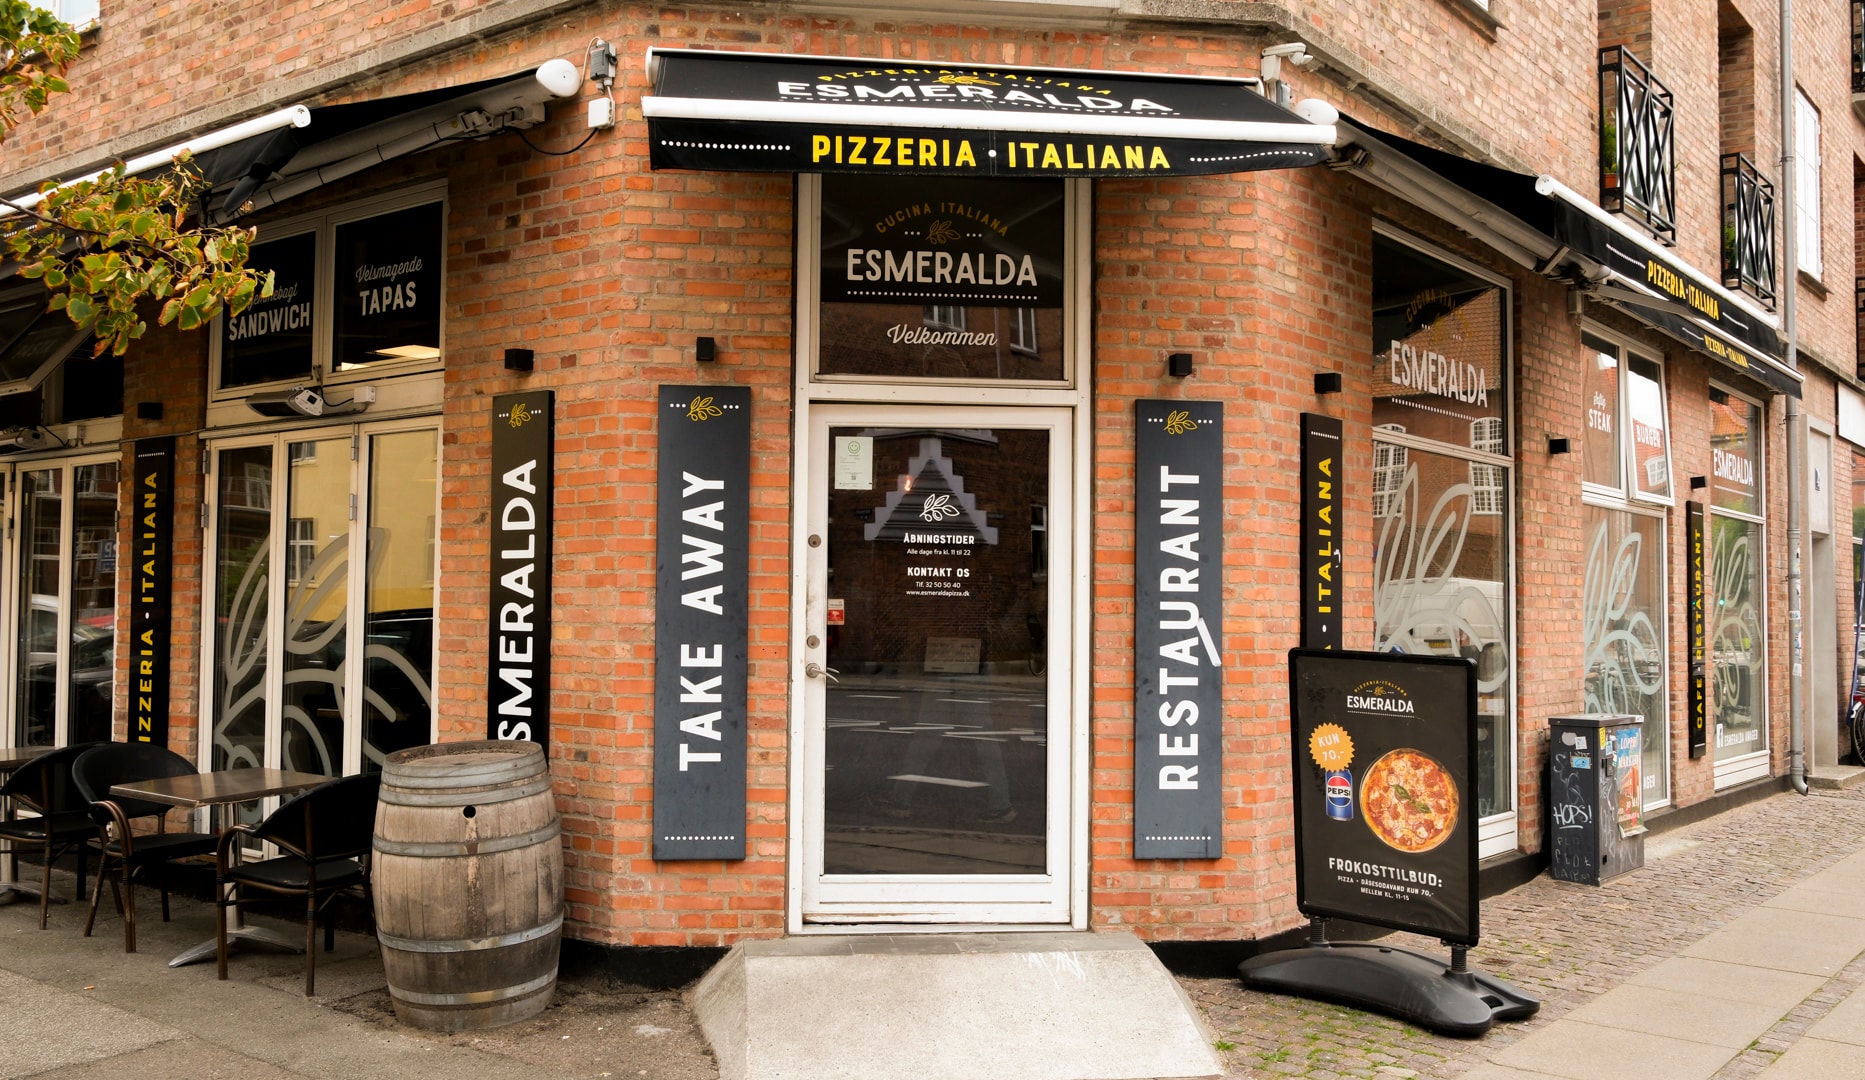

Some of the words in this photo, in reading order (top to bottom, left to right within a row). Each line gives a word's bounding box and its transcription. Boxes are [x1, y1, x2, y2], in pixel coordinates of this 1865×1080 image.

[777, 81, 1174, 112] ESMERALDA
[812, 135, 977, 168] PIZZERIA
[1008, 142, 1171, 169] ITALIANA
[876, 203, 932, 233] CUCINA
[941, 202, 1008, 237] ITALIANA
[355, 256, 423, 283] Velsmagende
[847, 248, 1038, 287] ESMERALDA
[360, 281, 417, 316] TAPAS
[1406, 288, 1436, 323] CUCINA
[1647, 259, 1686, 300] PIZZERIA
[1688, 284, 1719, 321] ITALIANA
[228, 302, 310, 341] SANDWICH
[886, 323, 998, 346] Velkommen
[1391, 339, 1488, 408] ESMERALDA
[1588, 408, 1611, 433] STEAK
[1636, 424, 1661, 448] BURGER
[1713, 448, 1754, 487] ESMERALDA
[141, 471, 158, 603] ITALIANA
[681, 470, 725, 616] AWAY
[903, 532, 975, 544] ÅBNINGSTIDER
[1318, 457, 1332, 613] ITALIANA
[907, 567, 952, 577] KONTAKT
[956, 568, 970, 577] OS
[498, 459, 537, 742] SMERALDA
[1158, 465, 1200, 790] RESTAURANT
[138, 628, 154, 743] IZZERIA
[679, 644, 723, 772] TAKE
[1346, 695, 1415, 713] ESMERALDA
[1317, 733, 1340, 747] KUN
[1321, 749, 1345, 762] 70,-
[1643, 774, 1656, 790] AGER
[1553, 803, 1592, 826] HOPS!
[1328, 857, 1443, 887] FROKOSTTILBUD:
[1337, 875, 1354, 883] PIZZA
[1361, 879, 1405, 892] DÅSESODAVAND
[1360, 887, 1383, 896] MELLEM
